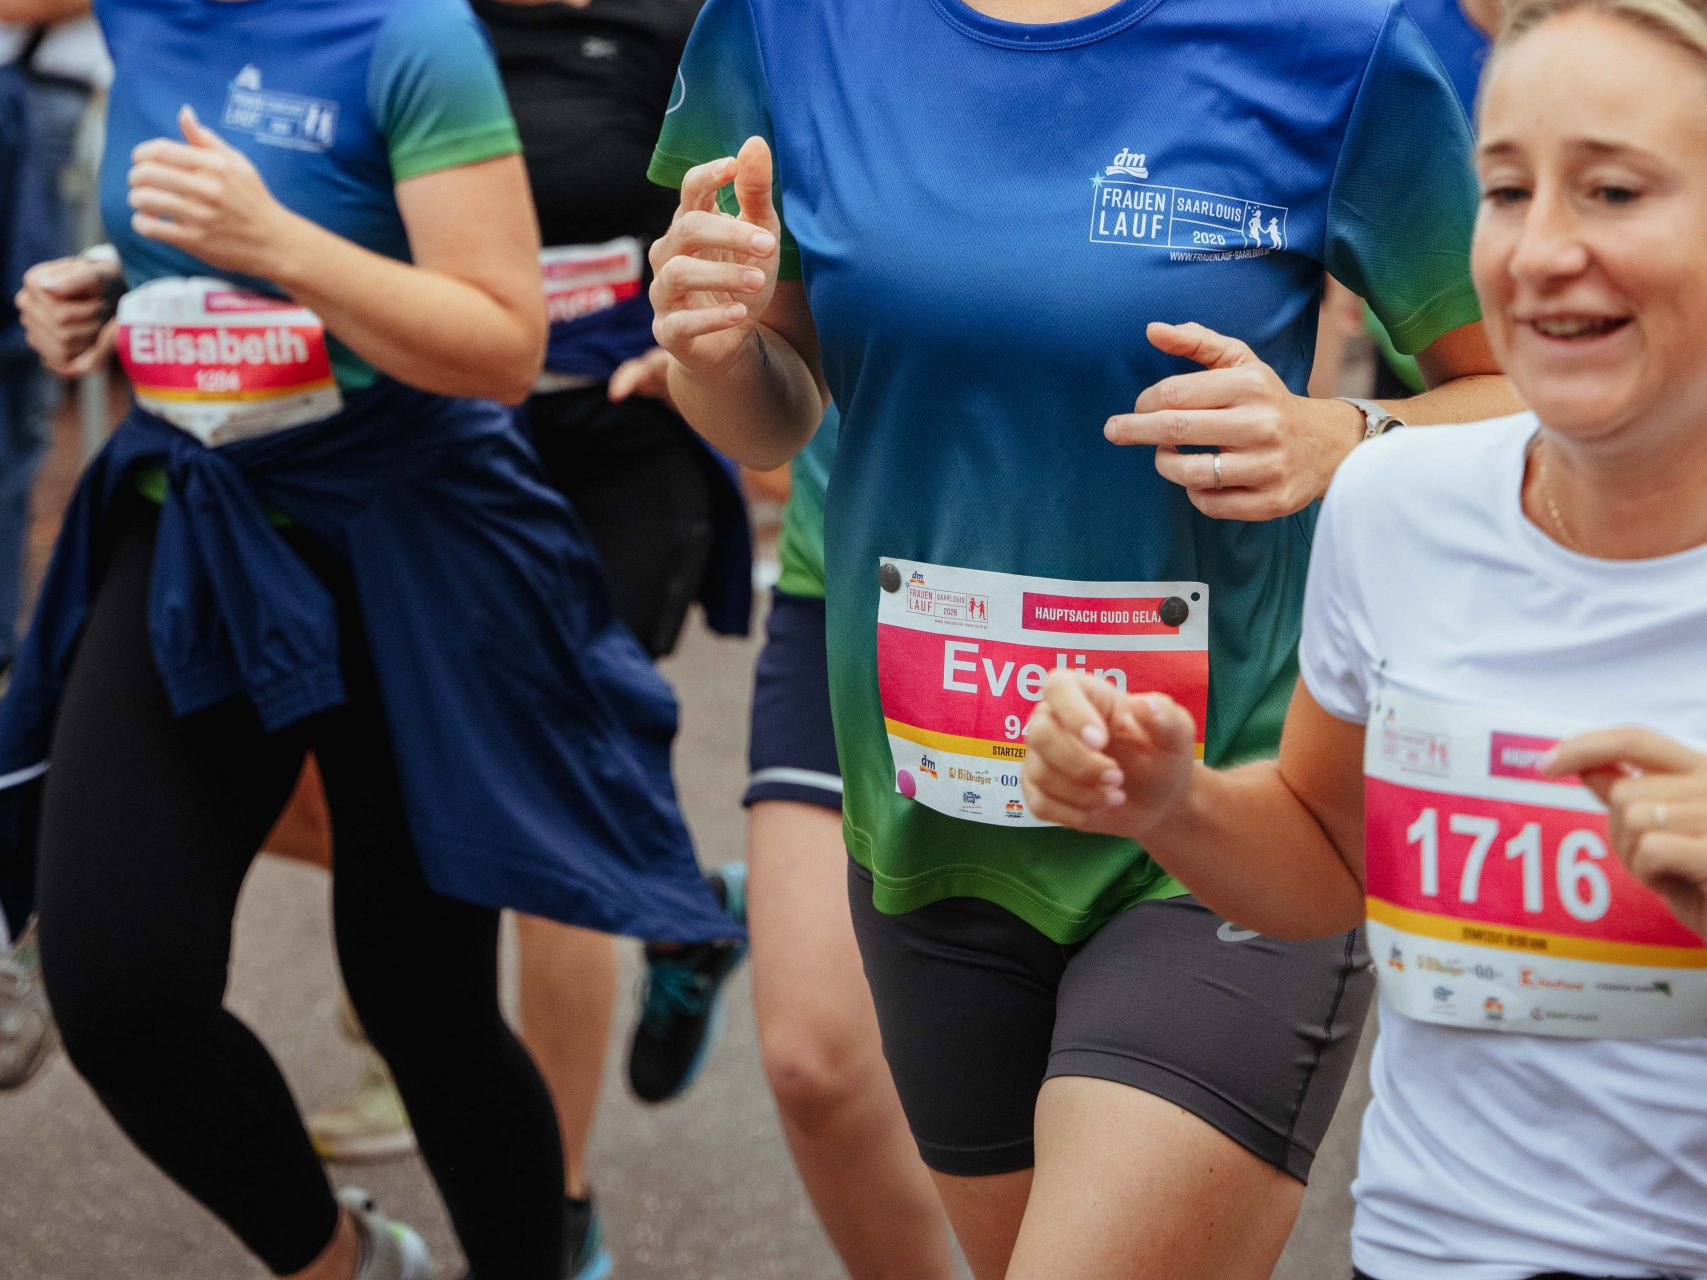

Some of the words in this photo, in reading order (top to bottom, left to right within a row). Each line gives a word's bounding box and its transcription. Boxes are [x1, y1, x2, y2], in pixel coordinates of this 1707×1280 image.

[1113, 147, 1146, 168] dm
[1101, 187, 1167, 212] FRAUEN
[1176, 197, 1242, 222] SAARLOUIS
[1098, 210, 1165, 239] LAUF
[1193, 231, 1226, 246] 2026
[129, 325, 309, 365] Elisabeth
[911, 570, 924, 580] dm
[909, 588, 933, 601] FRAUEN
[936, 593, 965, 604] SAARLOUIS
[909, 599, 933, 613] LAUF
[943, 607, 958, 617] 2026
[1034, 606, 1098, 623] HAUPTSACH
[1100, 610, 1130, 624] GUDD
[921, 754, 936, 771] dm
[1406, 807, 1611, 922] 1716
